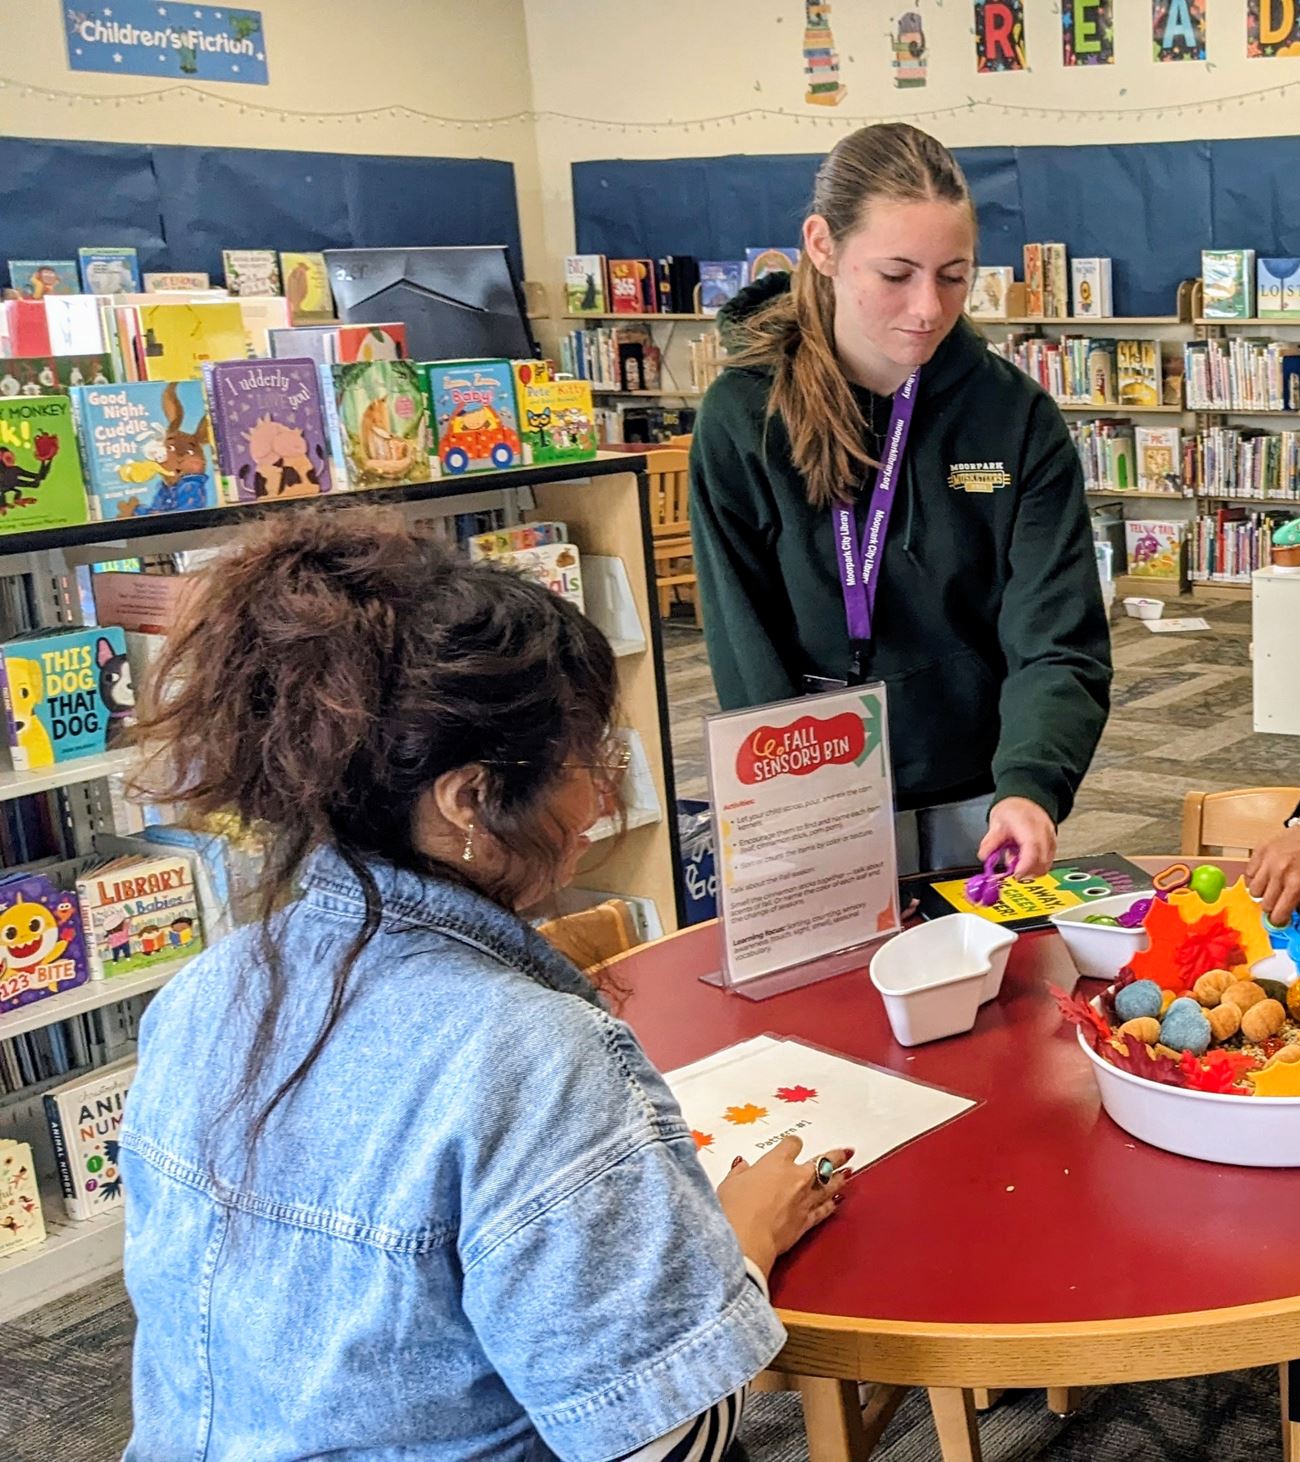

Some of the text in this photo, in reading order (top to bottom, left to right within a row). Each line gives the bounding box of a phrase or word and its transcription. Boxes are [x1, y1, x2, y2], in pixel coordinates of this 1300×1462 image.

[80, 19, 254, 56] Children's Fiction
[240, 369, 291, 391] udderly
[9, 403, 67, 418] MONKEY
[88, 391, 127, 405] Good
[95, 419, 148, 439] Cuddle
[96, 440, 138, 458] Tight
[880, 419, 904, 491] moorparklibrary.org
[949, 462, 1004, 471] MOORPARK
[869, 510, 885, 545] Moorpark
[840, 510, 856, 586] Moorpark City Library
[866, 543, 880, 561] City
[42, 645, 91, 674] THIS
[47, 690, 97, 718] THAT
[52, 712, 102, 740] DOG.
[783, 726, 819, 752] FALL
[753, 736, 849, 782] SENSORY BIN
[97, 867, 185, 905] LIBRARY
[135, 895, 183, 915] Babies
[1003, 889, 1042, 913] GREEN
[1, 961, 75, 998] 123 BITE
[79, 1090, 128, 1124] ANI
[51, 1122, 64, 1157] ANIMAL
[755, 1119, 813, 1149] Pattern #1
